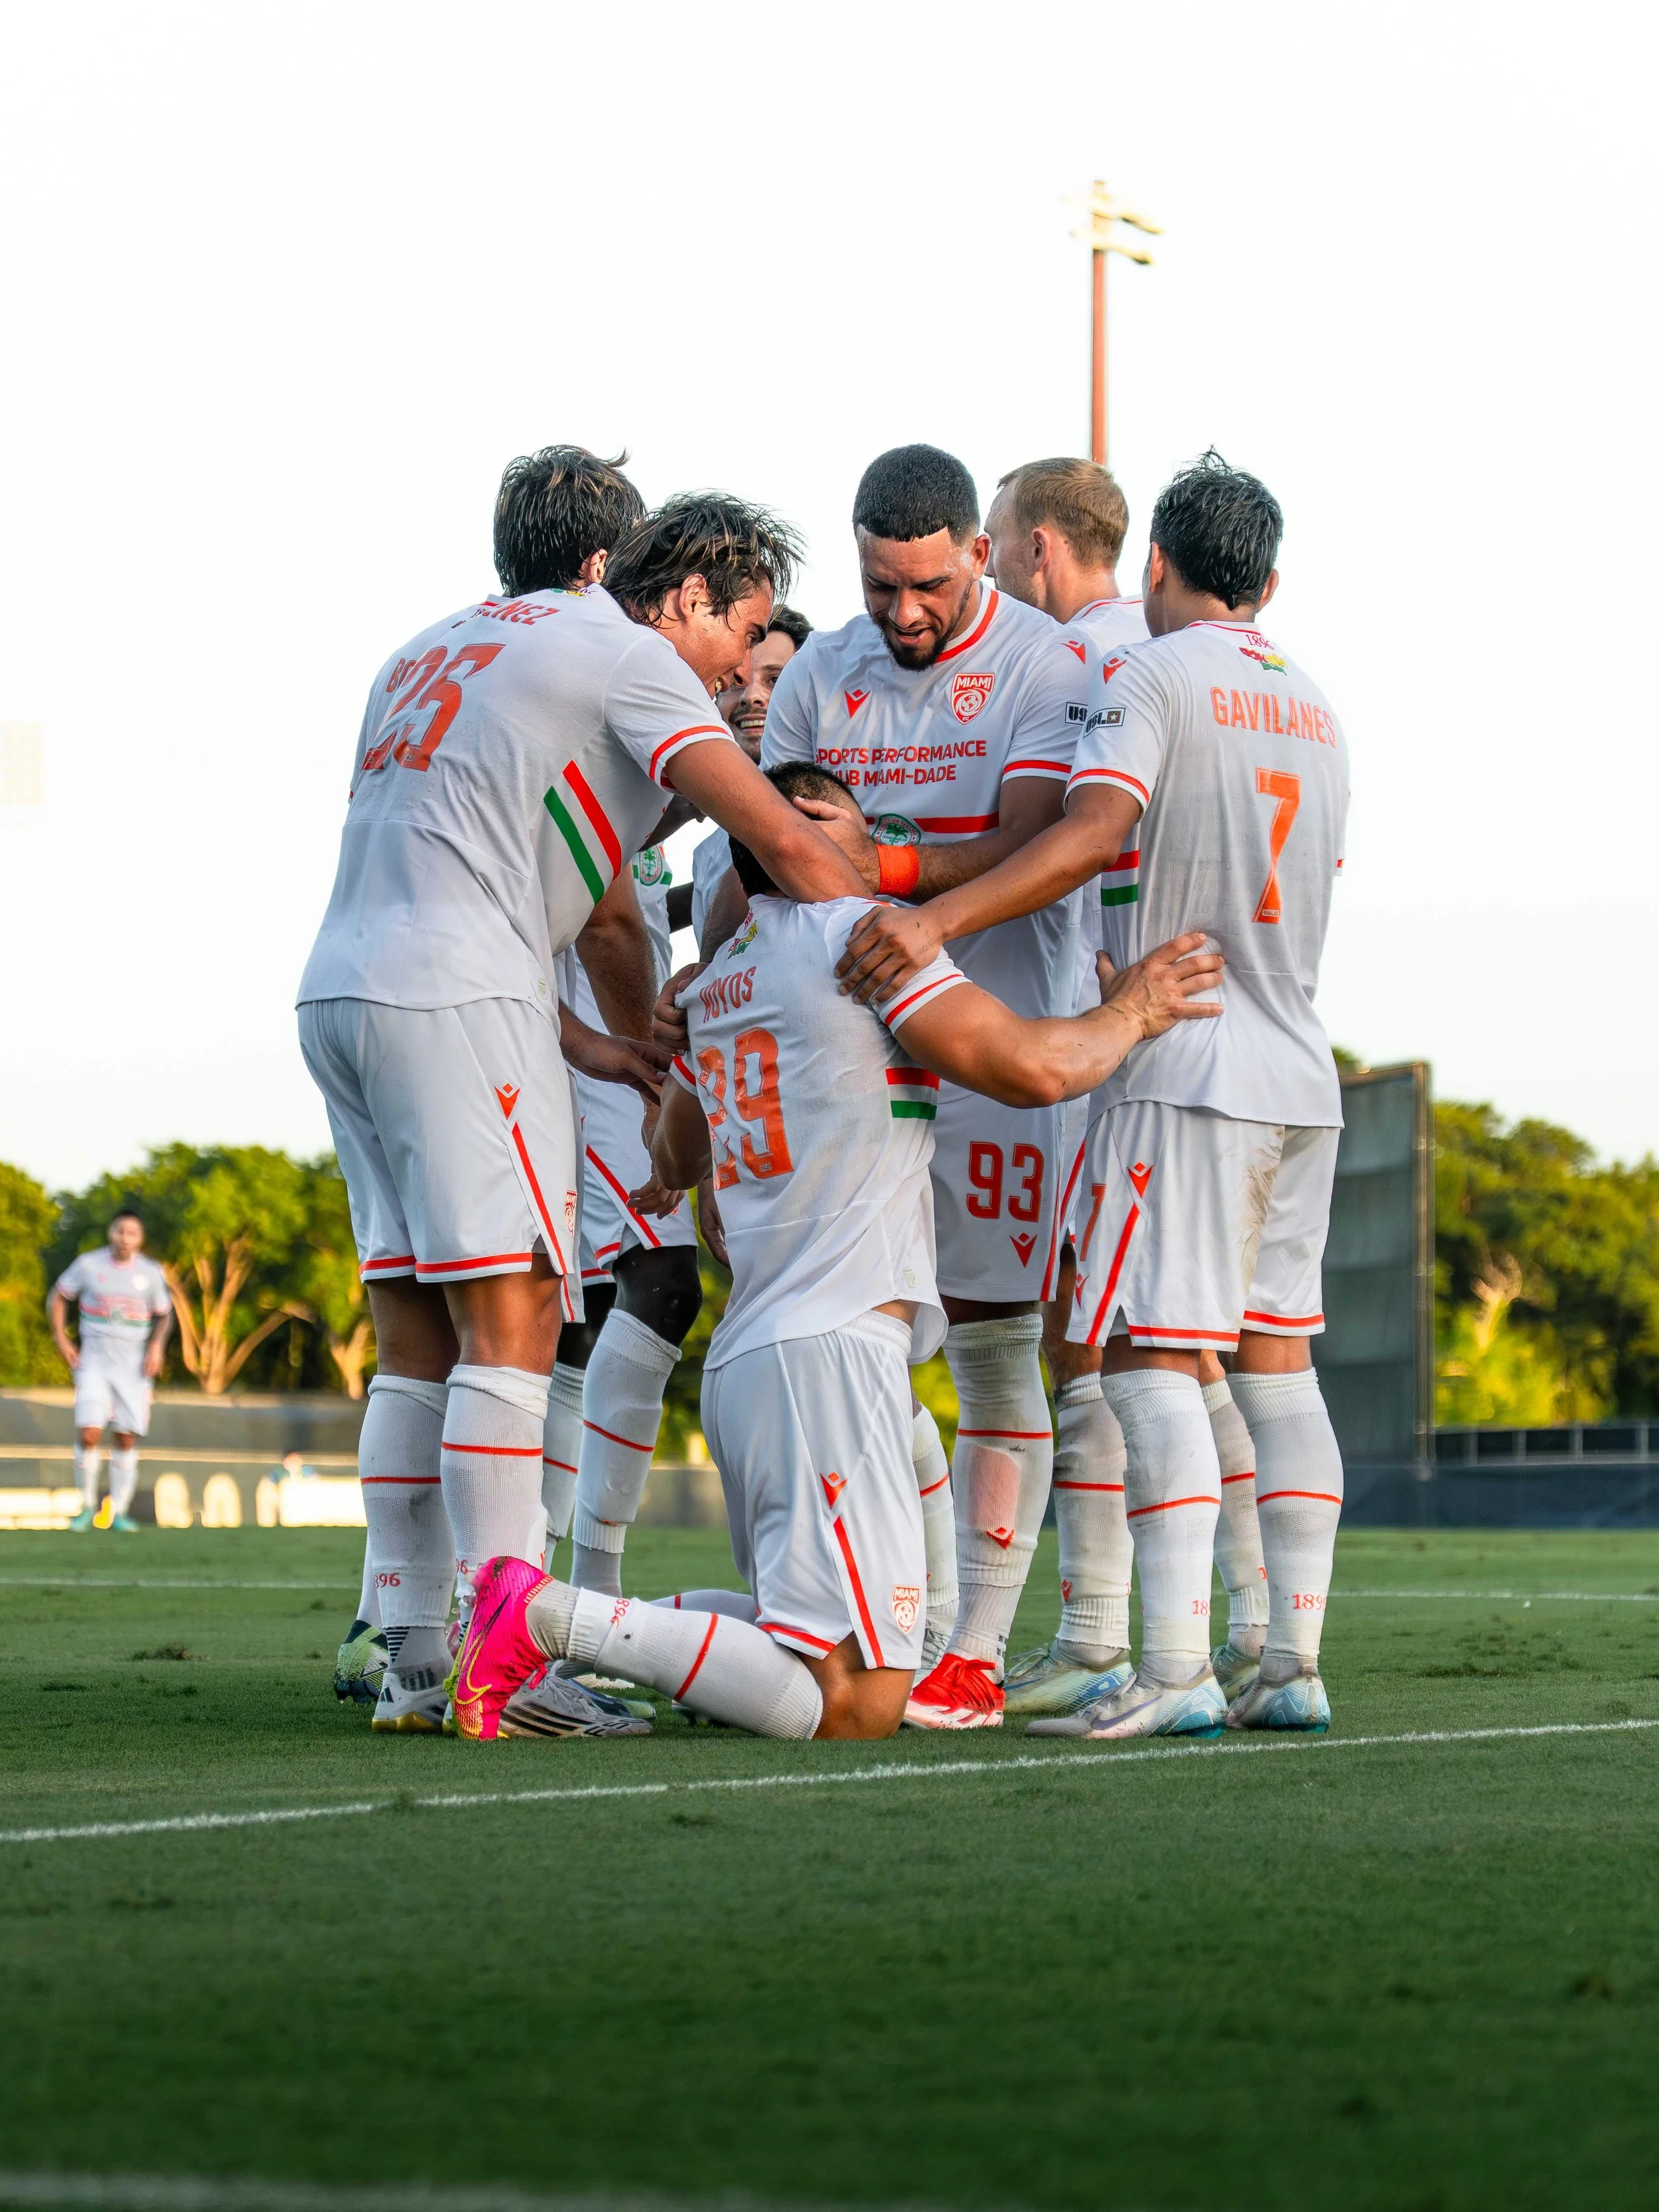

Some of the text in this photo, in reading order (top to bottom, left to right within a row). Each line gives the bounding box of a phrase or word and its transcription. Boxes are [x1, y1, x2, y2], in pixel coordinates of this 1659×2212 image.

[956, 676, 992, 690] MIAMI
[1210, 686, 1337, 748] GAVILANES
[816, 740, 987, 765] PORTS PERFORMANCE
[835, 765, 957, 786] UB MAMI-DADE
[1252, 766, 1301, 924] 7
[699, 966, 757, 1023] HOYOS
[966, 1141, 1045, 1222] 93
